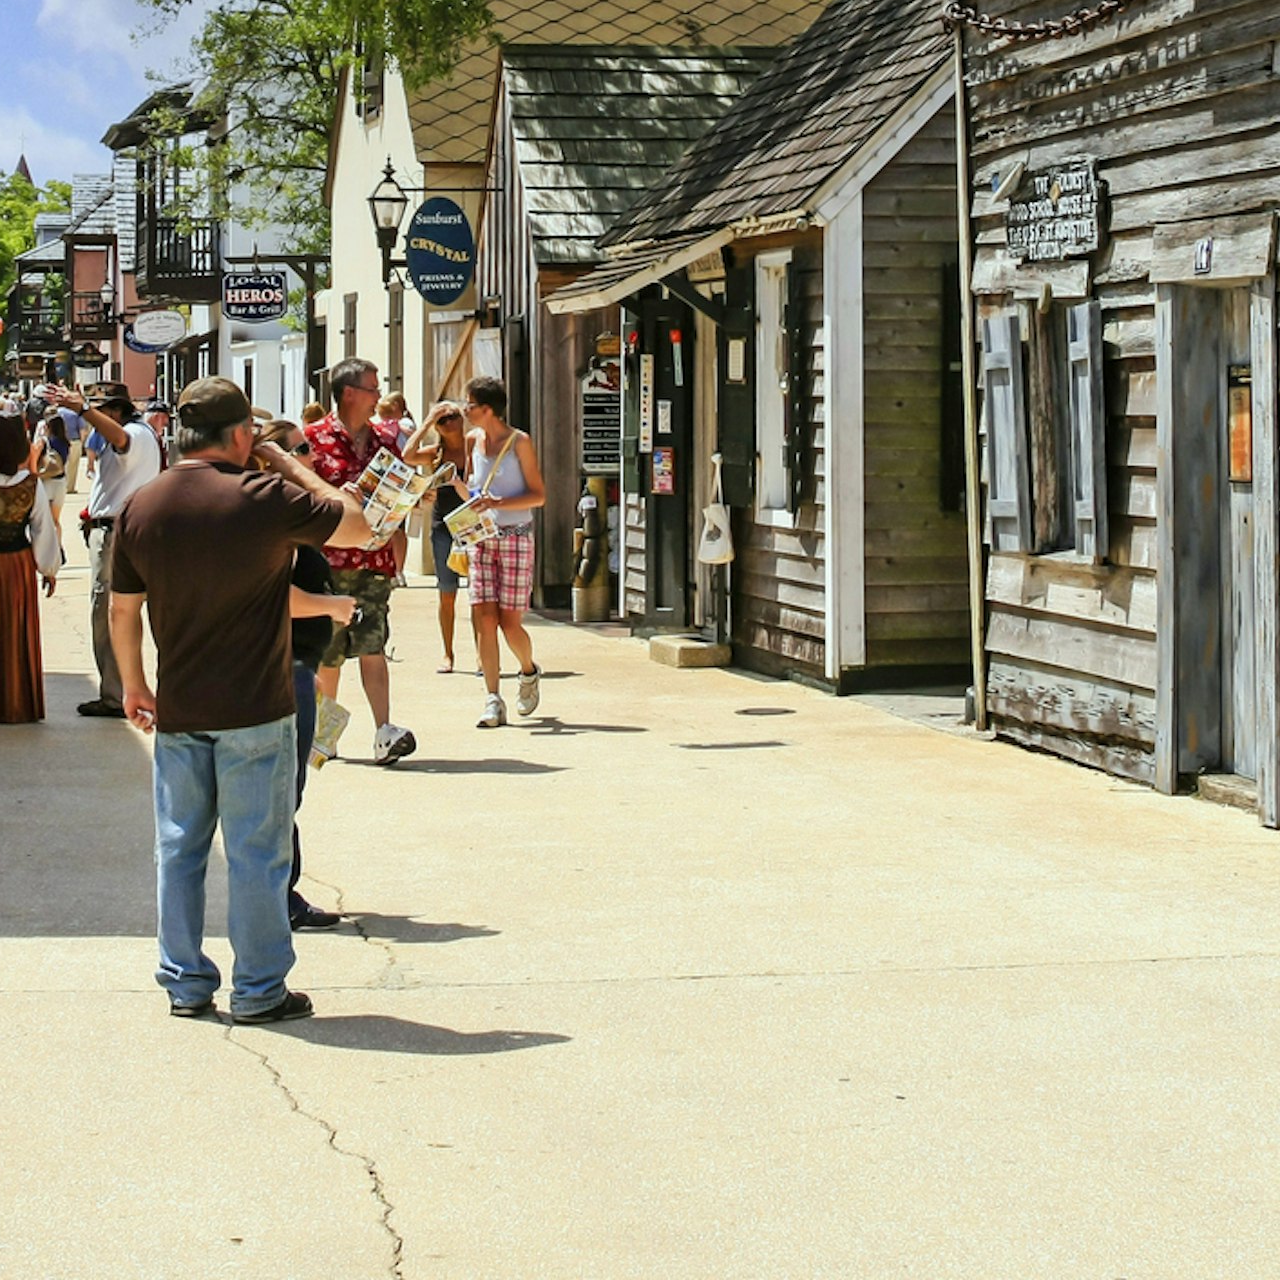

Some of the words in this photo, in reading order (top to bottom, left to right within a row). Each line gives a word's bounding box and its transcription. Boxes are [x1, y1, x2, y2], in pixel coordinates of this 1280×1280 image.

[415, 211, 463, 225] Sunburst
[410, 237, 470, 262] CRYSTAL
[229, 276, 280, 287] LOCAL
[421, 282, 463, 291] JEWELRY
[226, 288, 283, 303] HEROS
[230, 305, 247, 314] Bar
[248, 305, 257, 314] &
